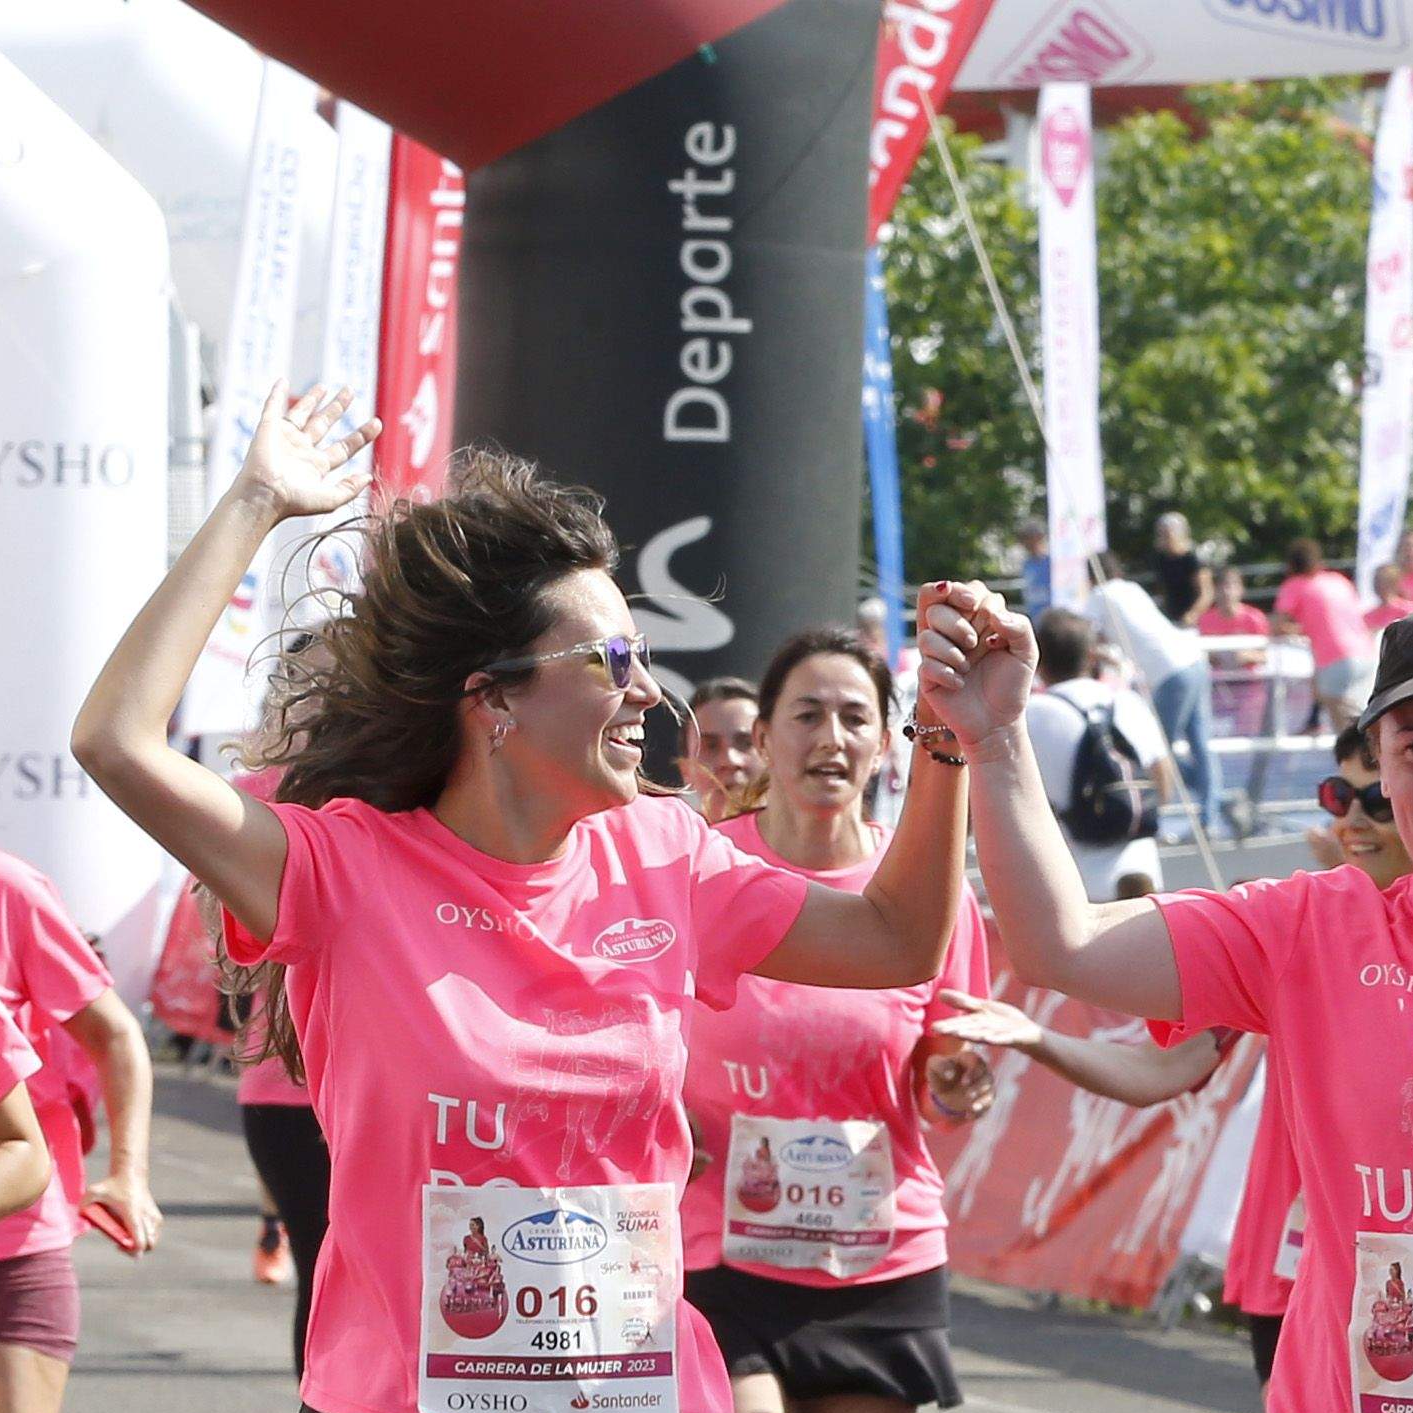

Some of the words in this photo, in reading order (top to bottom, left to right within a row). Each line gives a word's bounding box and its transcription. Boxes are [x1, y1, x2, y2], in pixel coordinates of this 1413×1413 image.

[664, 120, 753, 443] Deporte
[436, 903, 538, 941] OYSHO
[721, 1060, 768, 1099] TU
[428, 1093, 506, 1150] TU
[787, 1183, 844, 1206] 016
[1355, 1163, 1413, 1223] TU
[616, 1219, 660, 1232] SUMA
[511, 1229, 601, 1251] ASTURIANA
[516, 1285, 598, 1318] 016
[531, 1331, 581, 1350] 4981
[454, 1360, 527, 1375] CARRERA
[529, 1361, 551, 1375] DE
[555, 1361, 575, 1375] LA
[576, 1360, 622, 1375] MUJER
[627, 1359, 656, 1372] 2023
[447, 1392, 527, 1412] OYSHO
[592, 1391, 662, 1409] Santander
